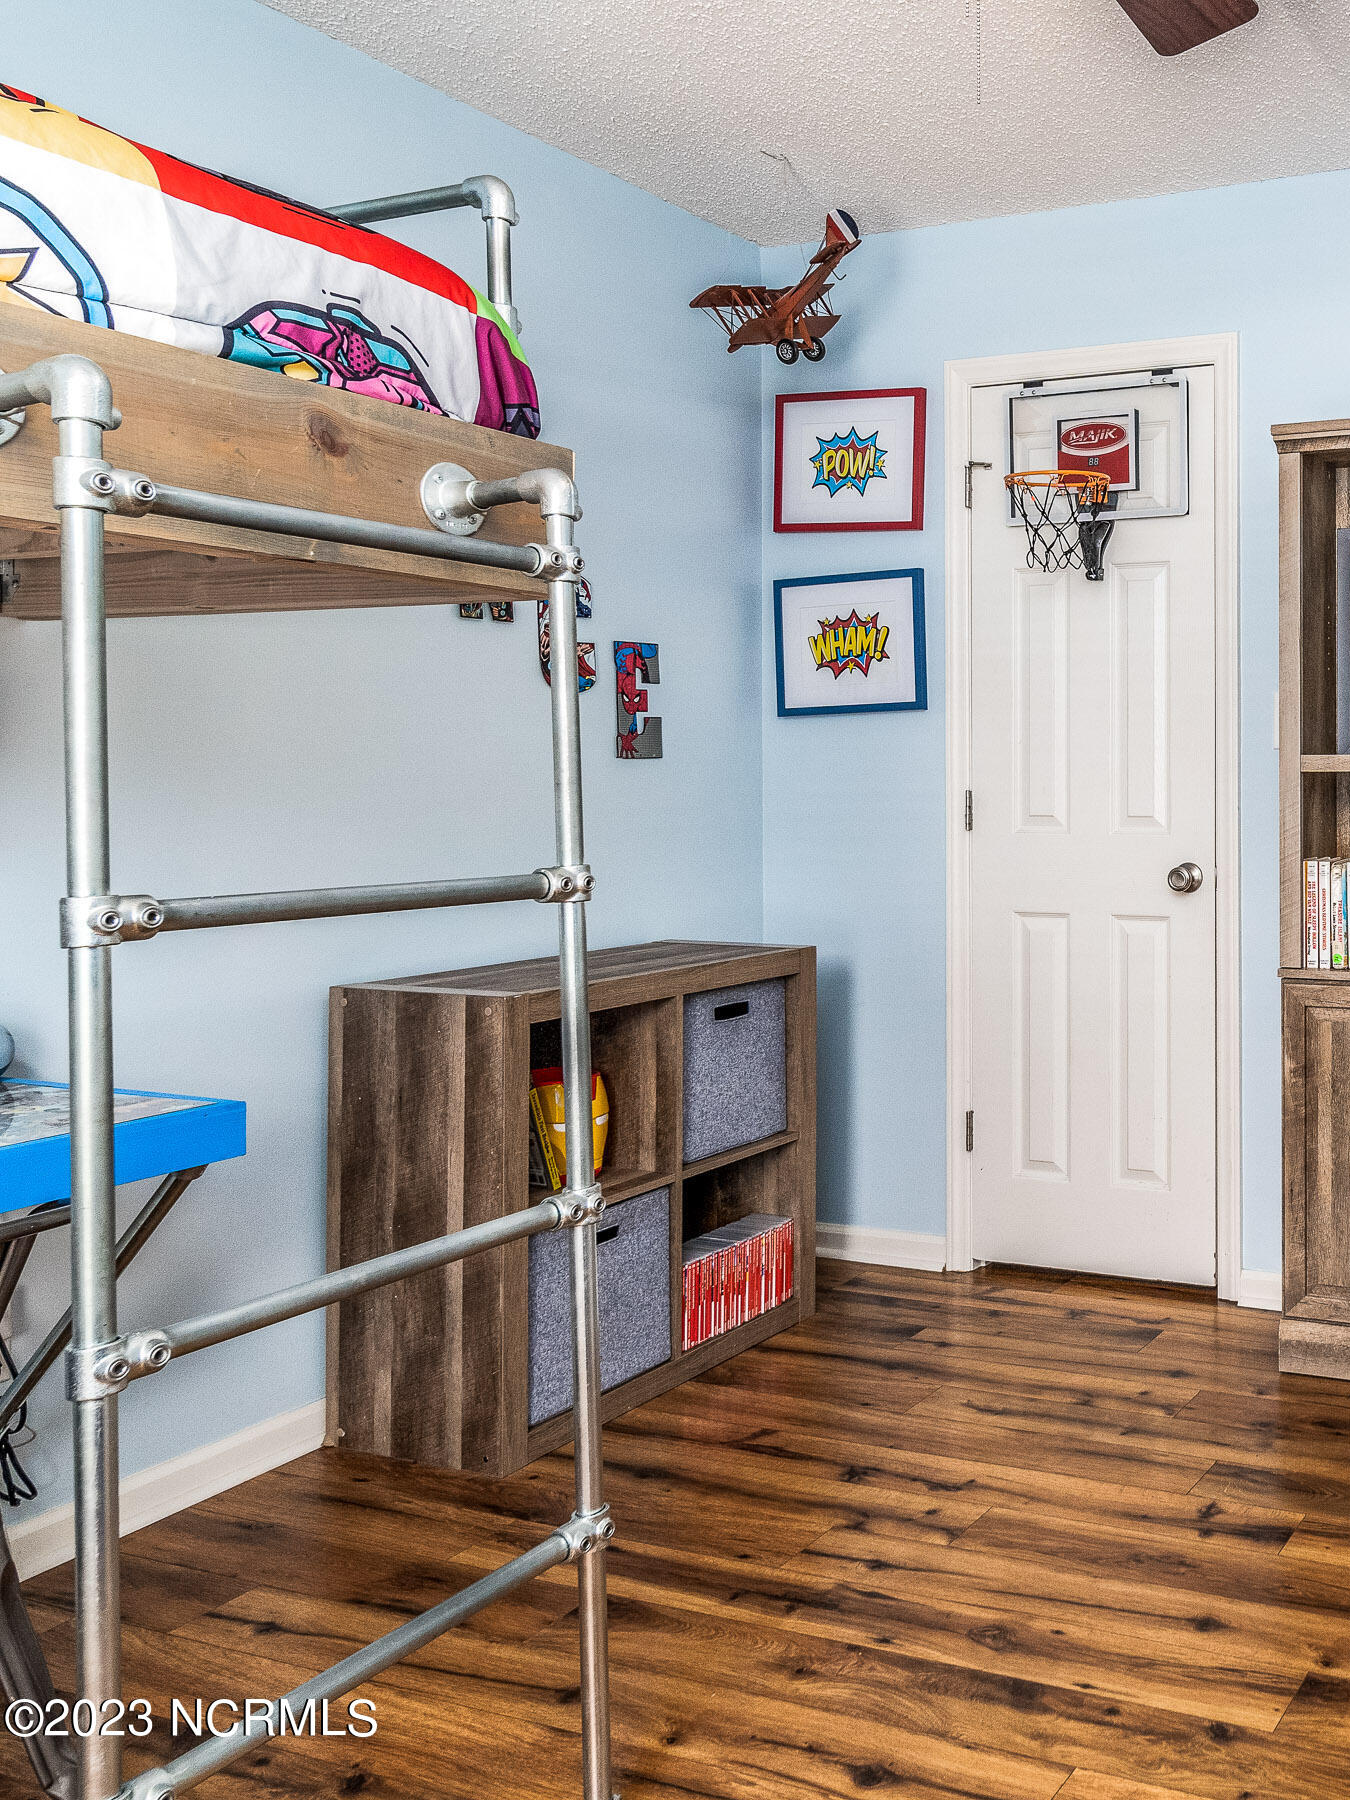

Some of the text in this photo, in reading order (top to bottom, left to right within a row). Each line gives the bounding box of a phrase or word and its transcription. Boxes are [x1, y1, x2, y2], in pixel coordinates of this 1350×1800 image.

[1068, 427, 1117, 446] MAJIK
[822, 445, 876, 480] POW!
[808, 626, 890, 665] WHAM!
